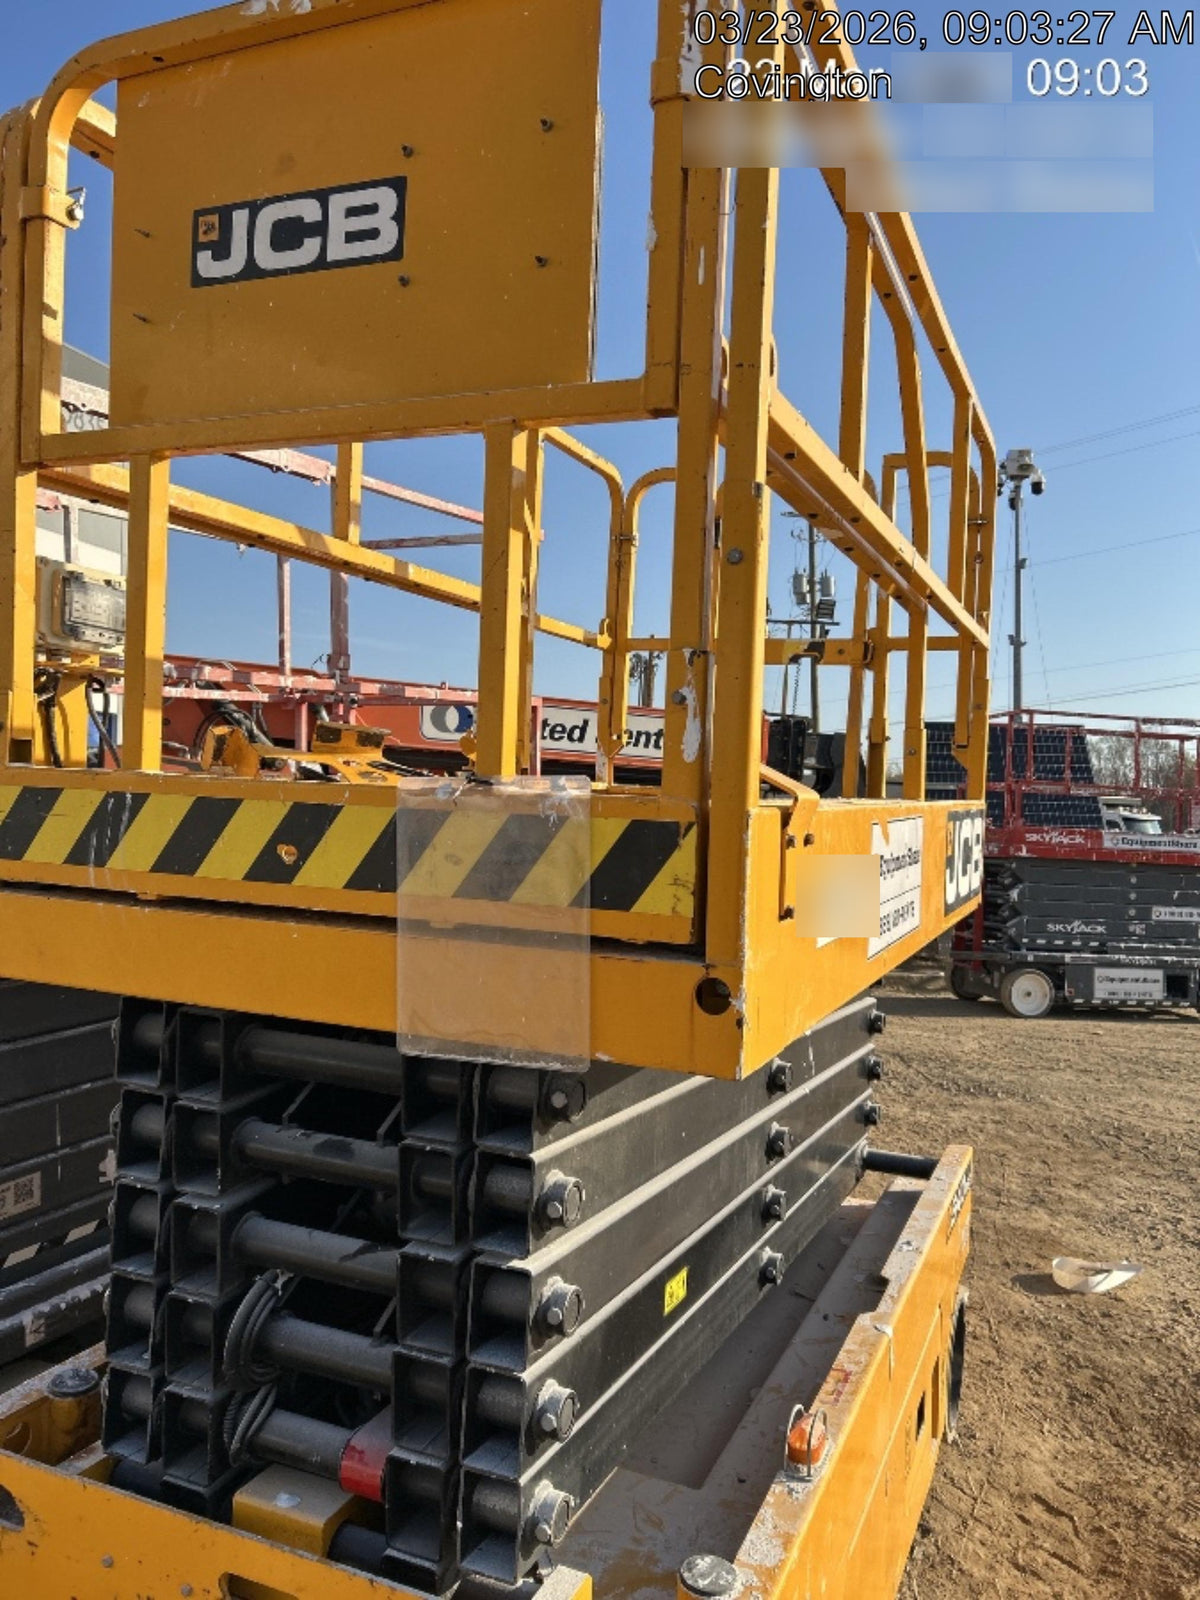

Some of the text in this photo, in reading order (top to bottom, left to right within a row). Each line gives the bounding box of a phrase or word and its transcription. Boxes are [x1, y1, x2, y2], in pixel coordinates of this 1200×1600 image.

[196, 186, 399, 279] JCB
[945, 817, 983, 904] JCB
[1024, 831, 1086, 845] SKYJACK
[1046, 919, 1107, 935] SKYJACK
